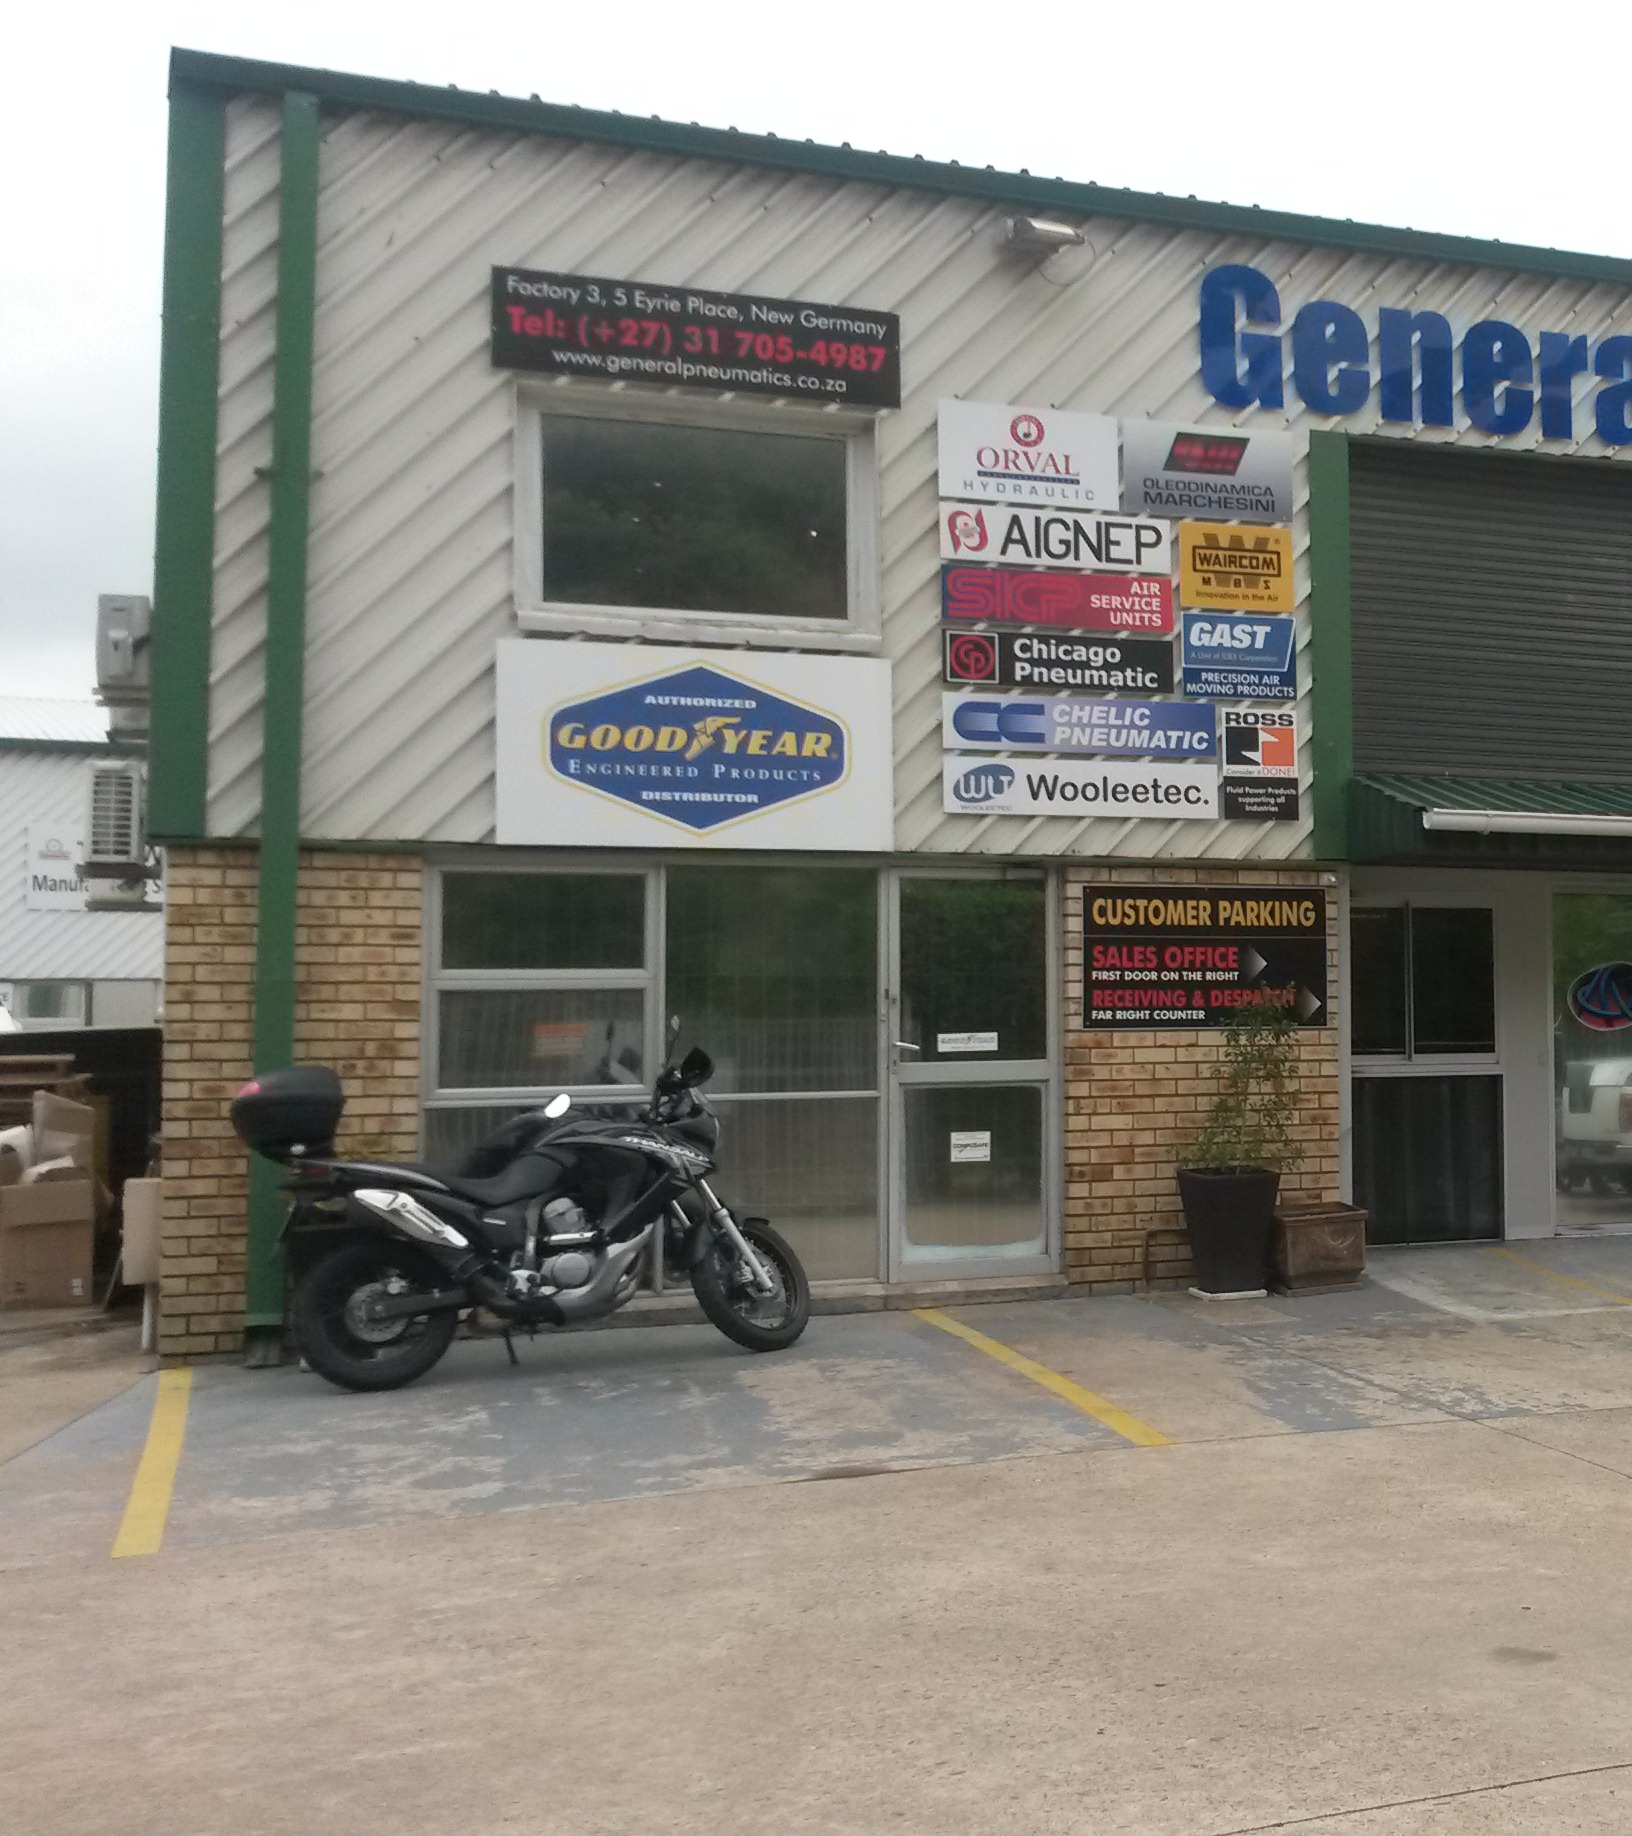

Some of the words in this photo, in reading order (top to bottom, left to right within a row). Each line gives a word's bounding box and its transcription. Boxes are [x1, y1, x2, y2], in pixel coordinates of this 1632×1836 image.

[506, 276, 579, 303] Factory
[587, 285, 607, 305] 3,
[615, 290, 627, 306] 5
[634, 292, 681, 314] Eyrie
[688, 297, 745, 322] Place,
[752, 304, 794, 326] New
[801, 311, 887, 339] Germany
[506, 306, 565, 337] Tel:
[578, 315, 672, 354] (+27)
[683, 326, 721, 354] 31
[736, 333, 886, 372] 705-4987
[553, 349, 847, 393] www.generalpneumatics.co.za
[977, 447, 1080, 476] ORVAL
[963, 479, 1095, 501] HYDRAULIC
[1143, 492, 1276, 514] MARCHESINI
[1000, 514, 1162, 565] AIGNEP
[1198, 552, 1275, 571] WAIRCOM
[1130, 582, 1161, 595] AIR
[1090, 594, 1161, 610] SERVICE
[1110, 612, 1162, 626] UNITS
[1190, 622, 1271, 649] GAST
[1013, 638, 1121, 667] Chicago
[1014, 662, 1159, 688] Pneumatic
[1201, 672, 1258, 684] PRECISION
[1262, 674, 1280, 685] AIR
[1186, 683, 1234, 694] MOVING
[1237, 685, 1294, 697] PRODUCTS
[645, 694, 756, 709] AUTHORIZED
[1053, 704, 1151, 727] CHELIC
[1225, 712, 1294, 726] ROSS
[1054, 728, 1209, 750] PNEUMATIC
[568, 758, 698, 778] ENGINEERED
[713, 763, 822, 782] PRODUCTS
[641, 791, 759, 804] DISTRIBUTOR
[1026, 774, 1209, 806] Wooleetec.
[1226, 786, 1244, 794] Fluid
[1267, 787, 1296, 795] Products
[1092, 898, 1212, 926] CUSTOMER
[1218, 900, 1316, 927] PARKING
[1092, 945, 1157, 969] SALES
[1164, 947, 1239, 969] OFFICE
[1092, 971, 1121, 981] FIRST
[1124, 971, 1157, 981] DOOR
[1161, 971, 1179, 981] ON
[1182, 971, 1202, 981] THE
[1205, 971, 1240, 981] RIGHT
[1092, 989, 1187, 1007] RECEIVING
[1192, 990, 1205, 1007] &
[1092, 1010, 1113, 1020] FAR
[1116, 1010, 1150, 1020] RIGHT
[1154, 1010, 1206, 1020] COUNTER
